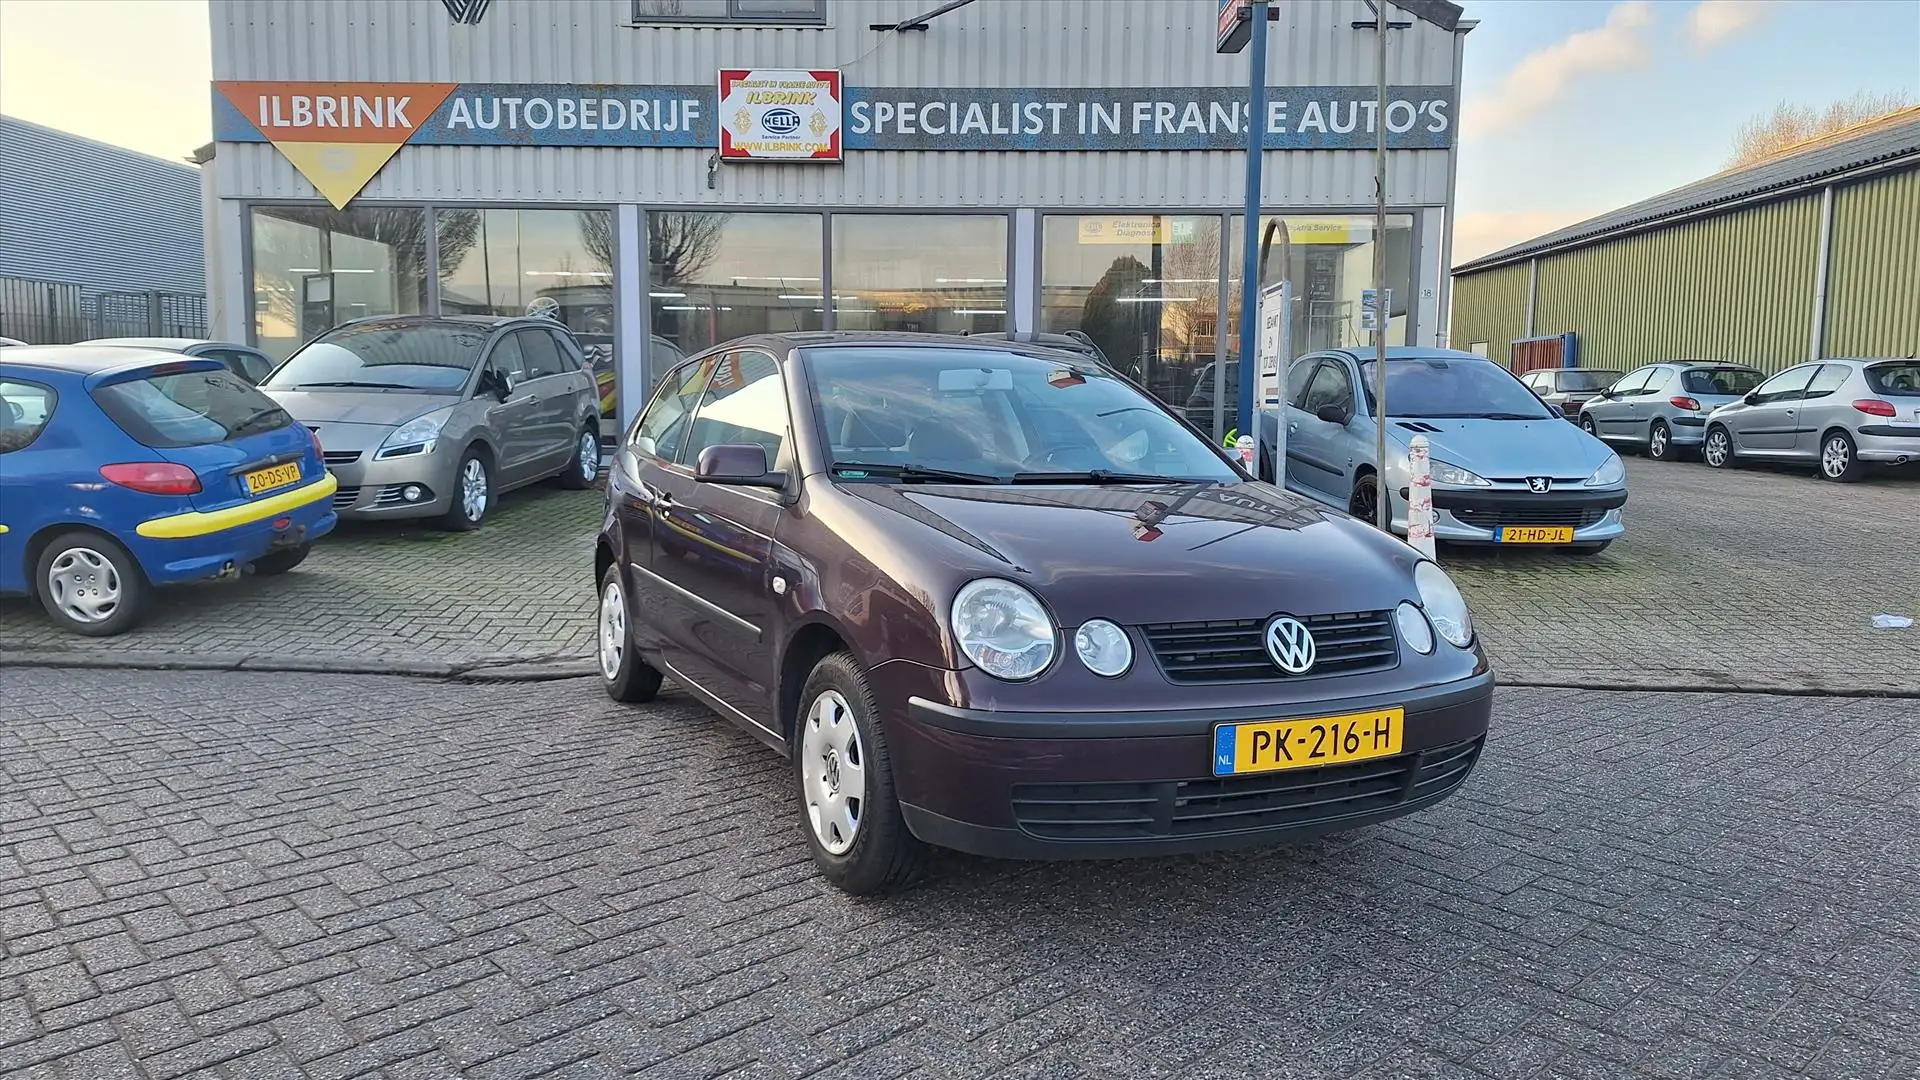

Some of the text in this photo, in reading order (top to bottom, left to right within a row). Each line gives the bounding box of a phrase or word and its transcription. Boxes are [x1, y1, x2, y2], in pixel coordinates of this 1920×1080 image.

[747, 91, 817, 105] ILBRINK
[259, 95, 413, 129] ILBRINK
[446, 97, 700, 132] AUTOBEDRIJF
[764, 115, 801, 127] HELLA
[850, 101, 1067, 135] SPECIALIST
[1078, 102, 1120, 134] IN
[1298, 100, 1449, 134] AUTO'S
[1423, 289, 1432, 297] 18
[249, 465, 296, 490] 20-DS-VP
[1508, 529, 1565, 541] 21-HD-JL
[1218, 716, 1391, 765] NL PK-216-H
